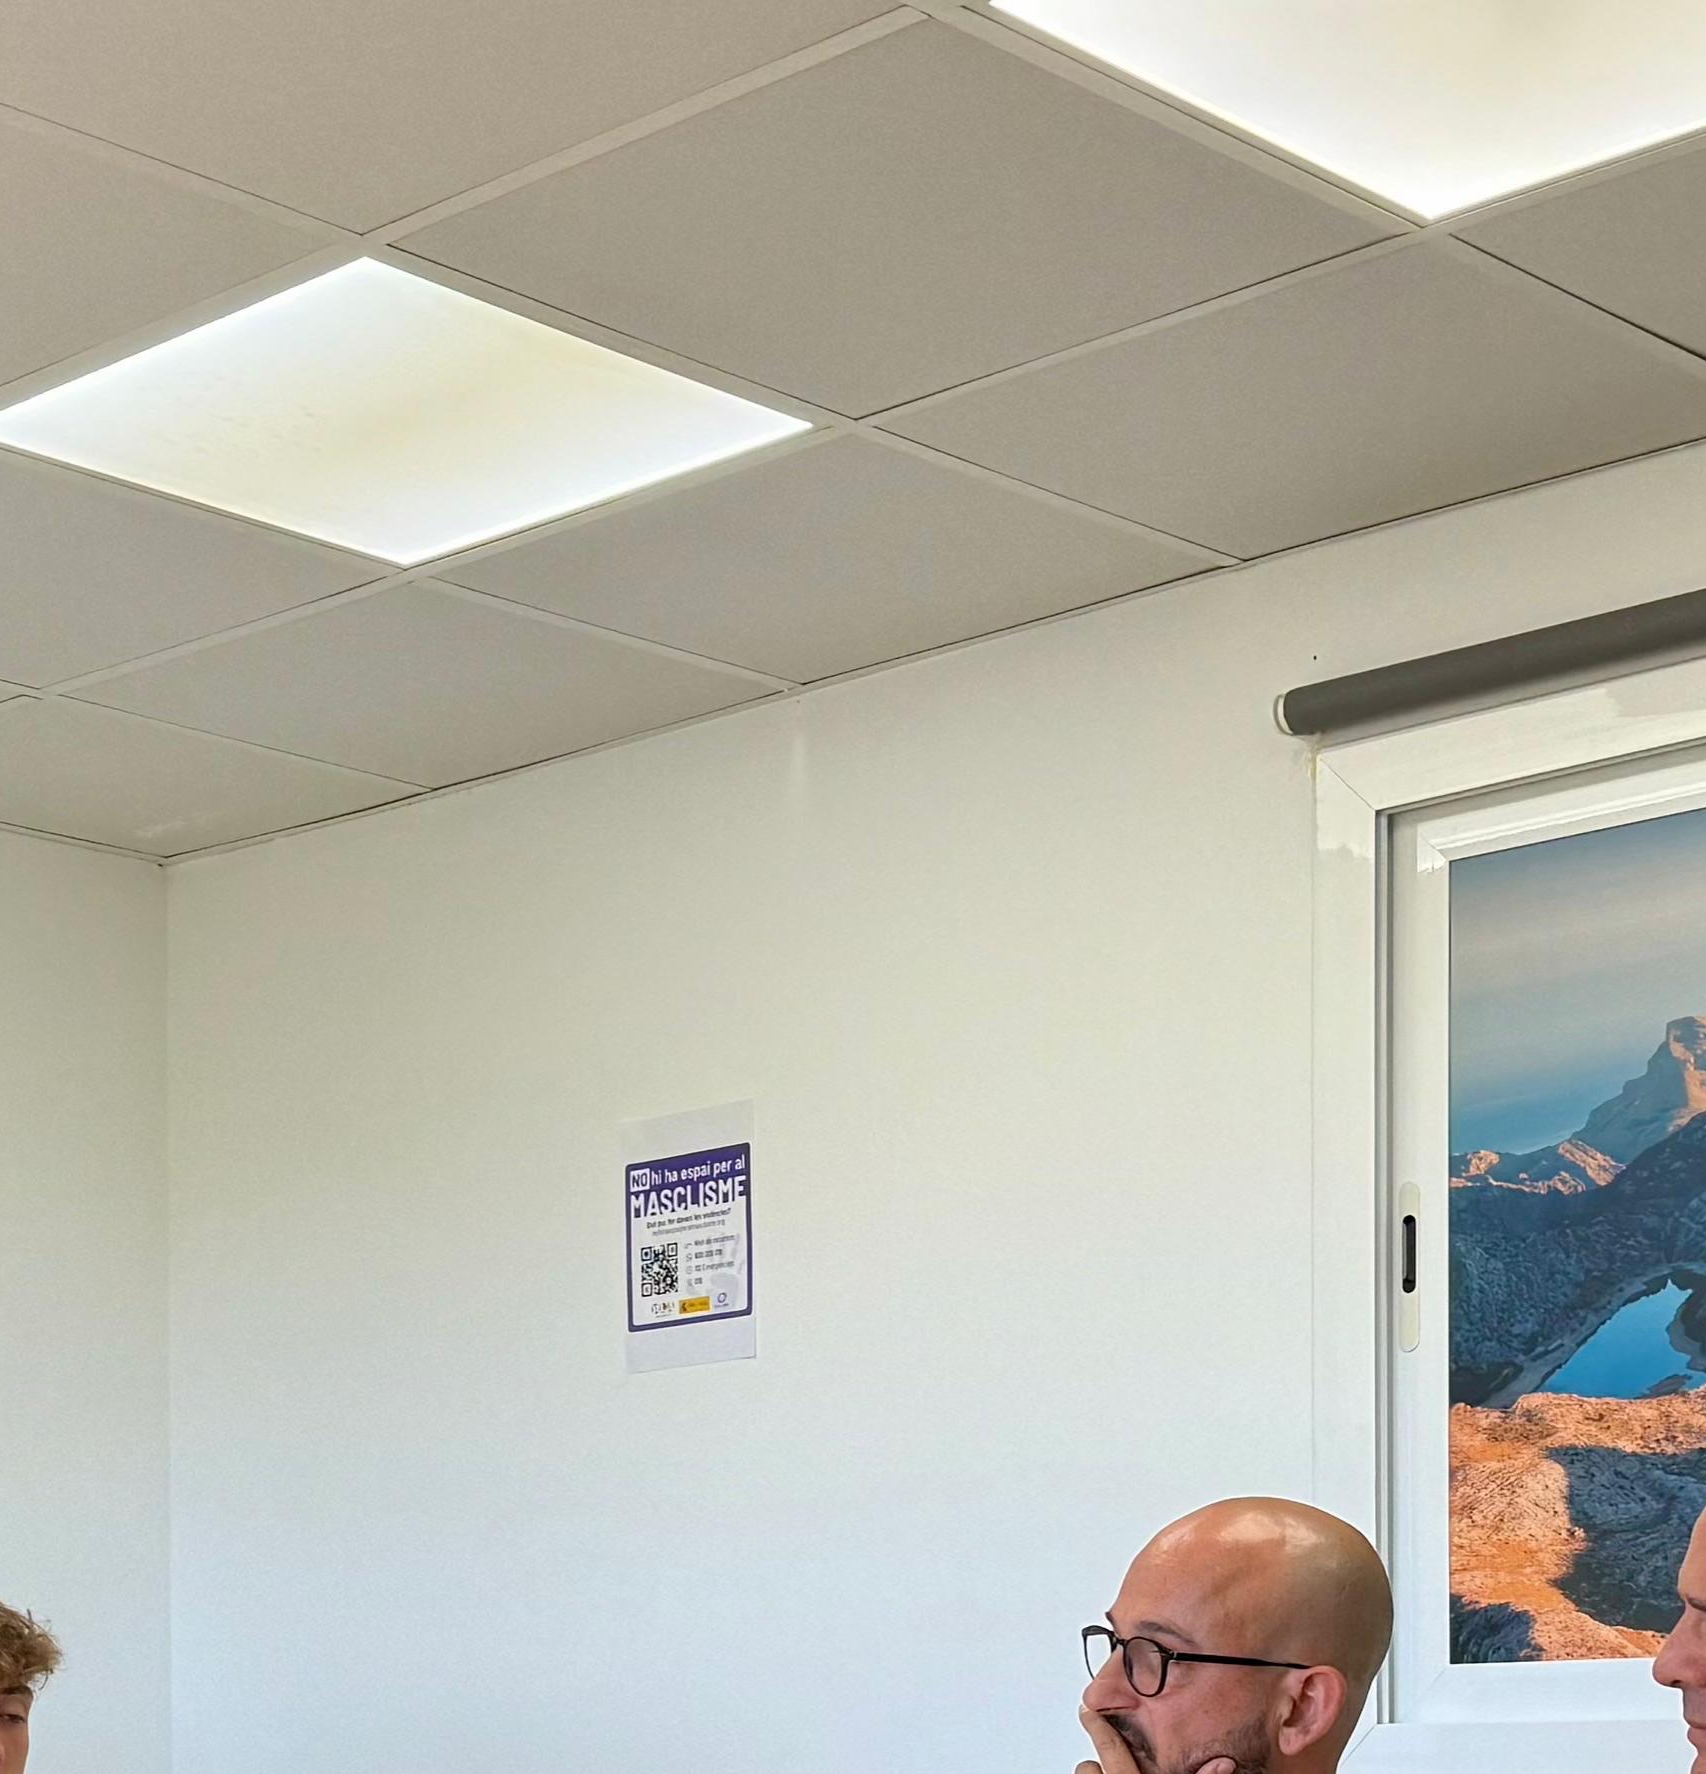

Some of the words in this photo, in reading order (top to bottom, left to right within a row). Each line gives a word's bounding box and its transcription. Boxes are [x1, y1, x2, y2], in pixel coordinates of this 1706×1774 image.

[632, 1172, 648, 1189] NO
[651, 1170, 662, 1185] hi
[664, 1169, 679, 1184] ha
[680, 1161, 711, 1182] espai
[713, 1160, 733, 1178] per
[735, 1154, 746, 1170] al
[631, 1175, 747, 1219] MASCLISME
